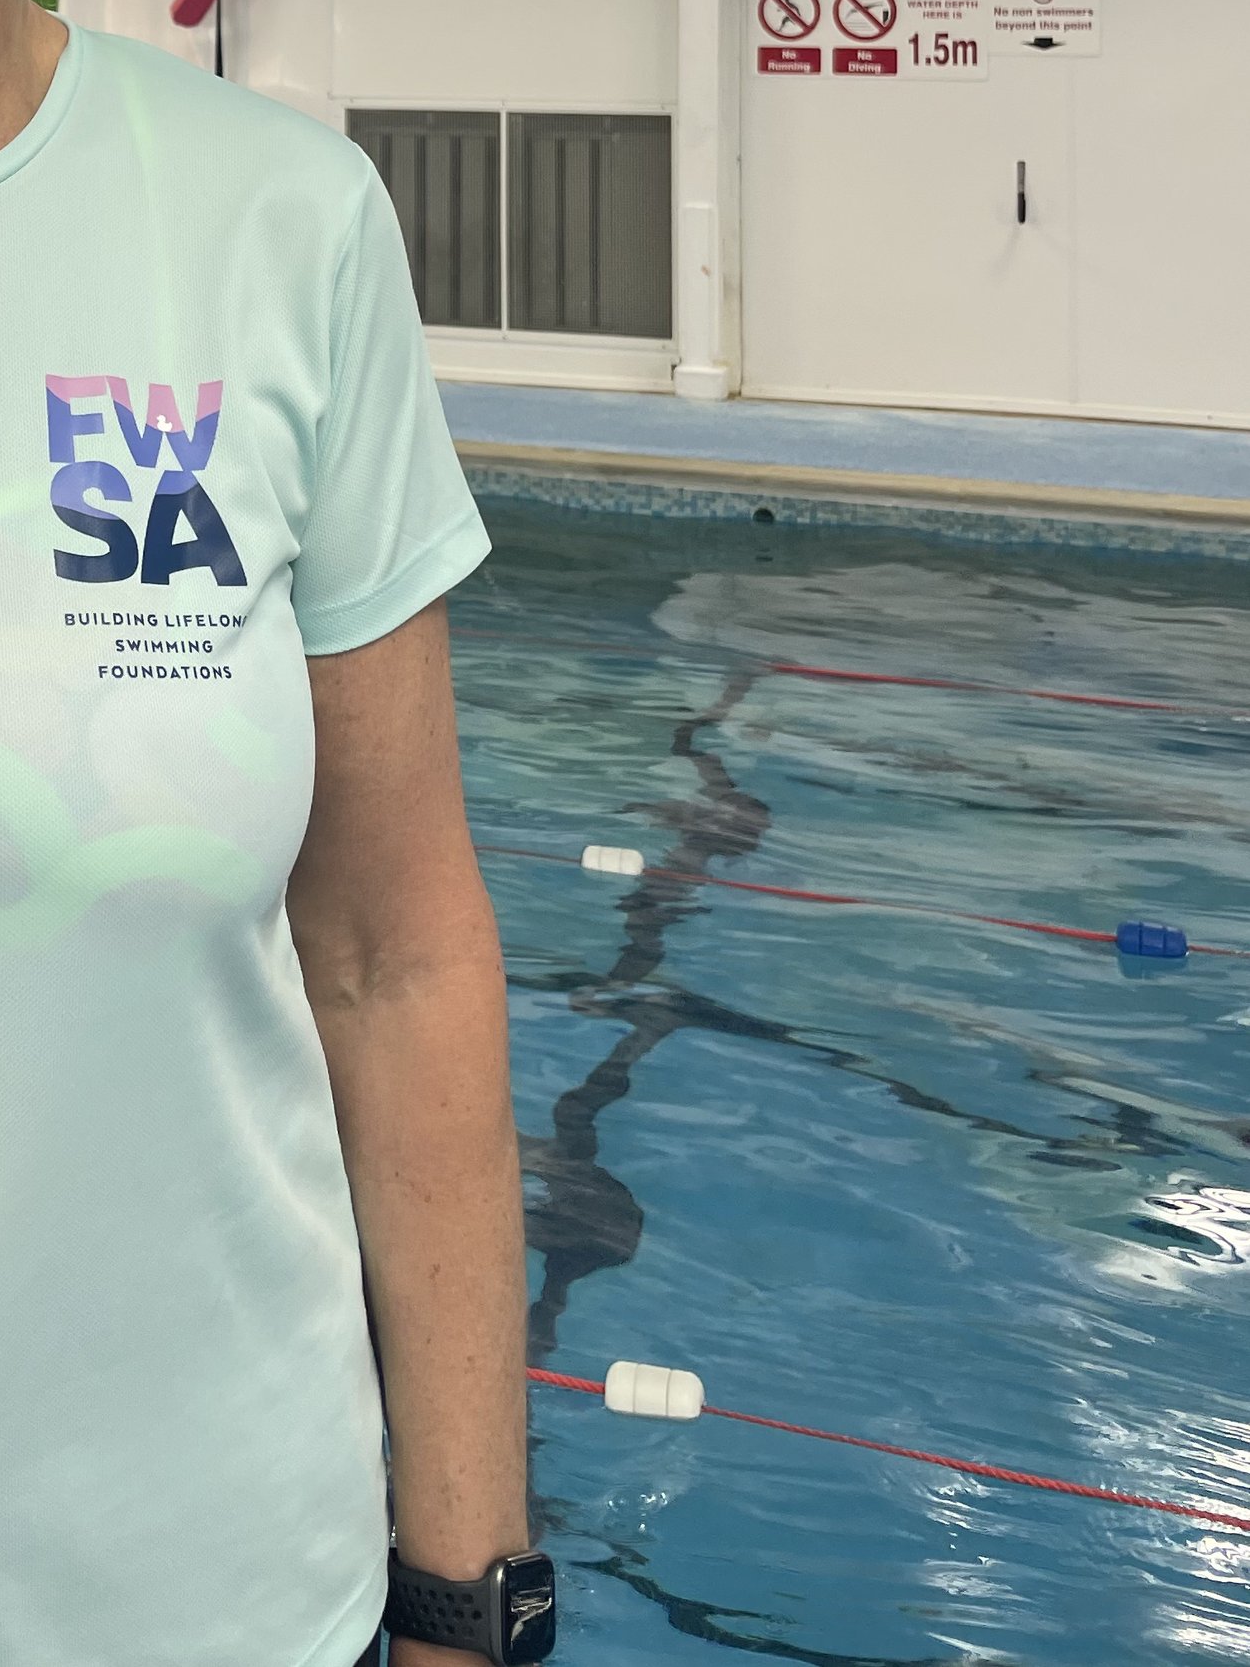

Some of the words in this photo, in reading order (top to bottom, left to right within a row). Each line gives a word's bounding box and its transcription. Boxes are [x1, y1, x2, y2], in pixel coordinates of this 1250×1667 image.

[907, 1, 942, 9] WATER
[944, 1, 979, 9] DEPTH
[923, 11, 949, 19] HERE
[952, 11, 962, 19] IS
[993, 7, 1009, 17] No
[1012, 9, 1033, 17] non
[1036, 8, 1094, 17] swimmers
[995, 21, 1036, 32] beyond
[1039, 21, 1060, 31] this
[1064, 21, 1092, 32] point
[908, 32, 978, 66] 1.5m
[781, 51, 796, 59] No
[857, 51, 872, 60] No
[768, 62, 811, 73] Running
[848, 63, 881, 74] Diving
[65, 612, 158, 627] BUILDING
[164, 614, 248, 628] LIFELON
[115, 639, 213, 653] SWIMMING
[98, 665, 233, 680] FOUNDATIONS
